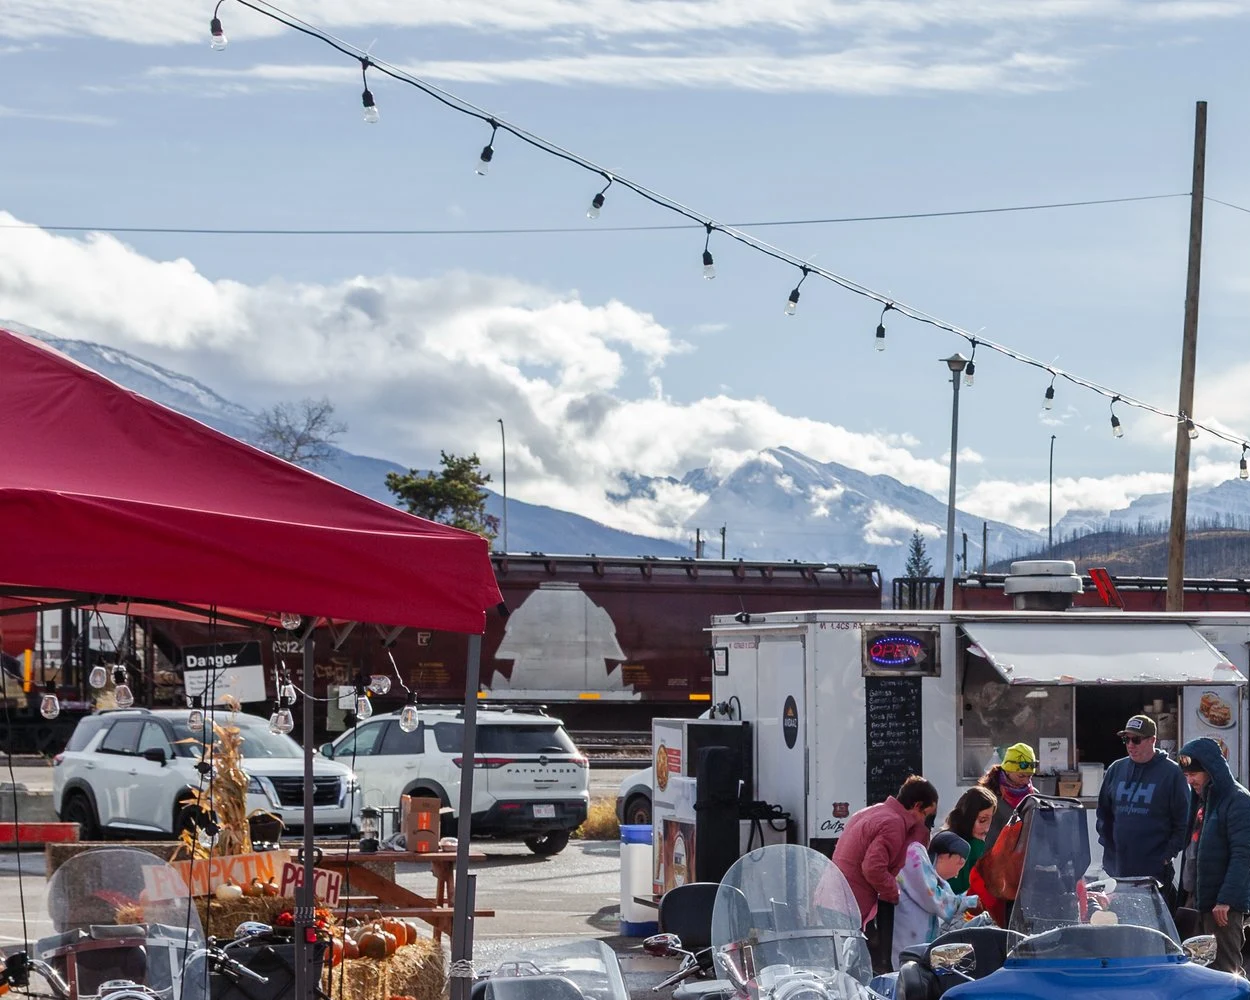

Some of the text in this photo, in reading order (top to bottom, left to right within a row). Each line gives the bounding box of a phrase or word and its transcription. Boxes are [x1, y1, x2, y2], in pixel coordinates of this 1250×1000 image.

[186, 653, 238, 668] Danger
[870, 644, 920, 658] OPEN
[1116, 781, 1156, 804] HH
[152, 853, 340, 904] PUMPKIN PACH
